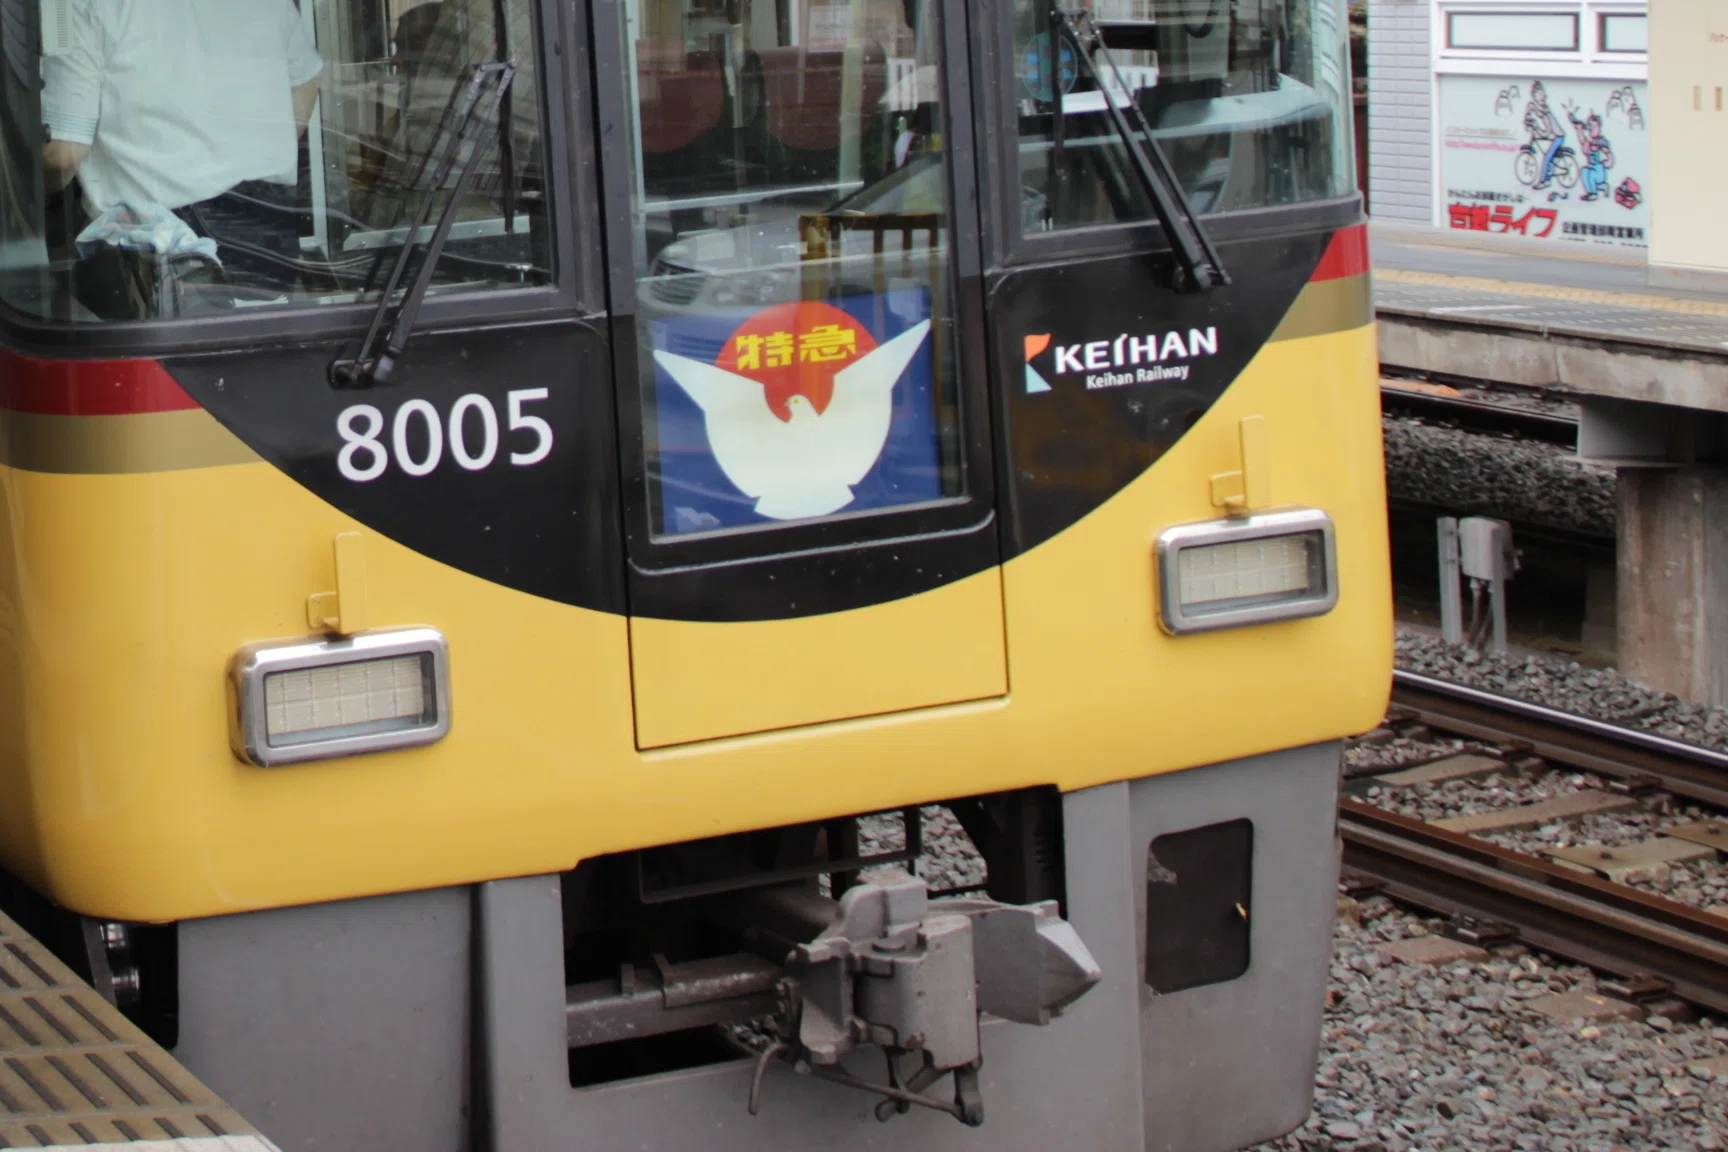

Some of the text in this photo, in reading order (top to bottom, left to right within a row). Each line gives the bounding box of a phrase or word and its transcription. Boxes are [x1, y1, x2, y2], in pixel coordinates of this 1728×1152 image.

[736, 324, 857, 371] 特急
[1055, 327, 1218, 375] KEIHAN
[1085, 364, 1190, 390] Keihan Railway
[336, 386, 554, 483] 8005
